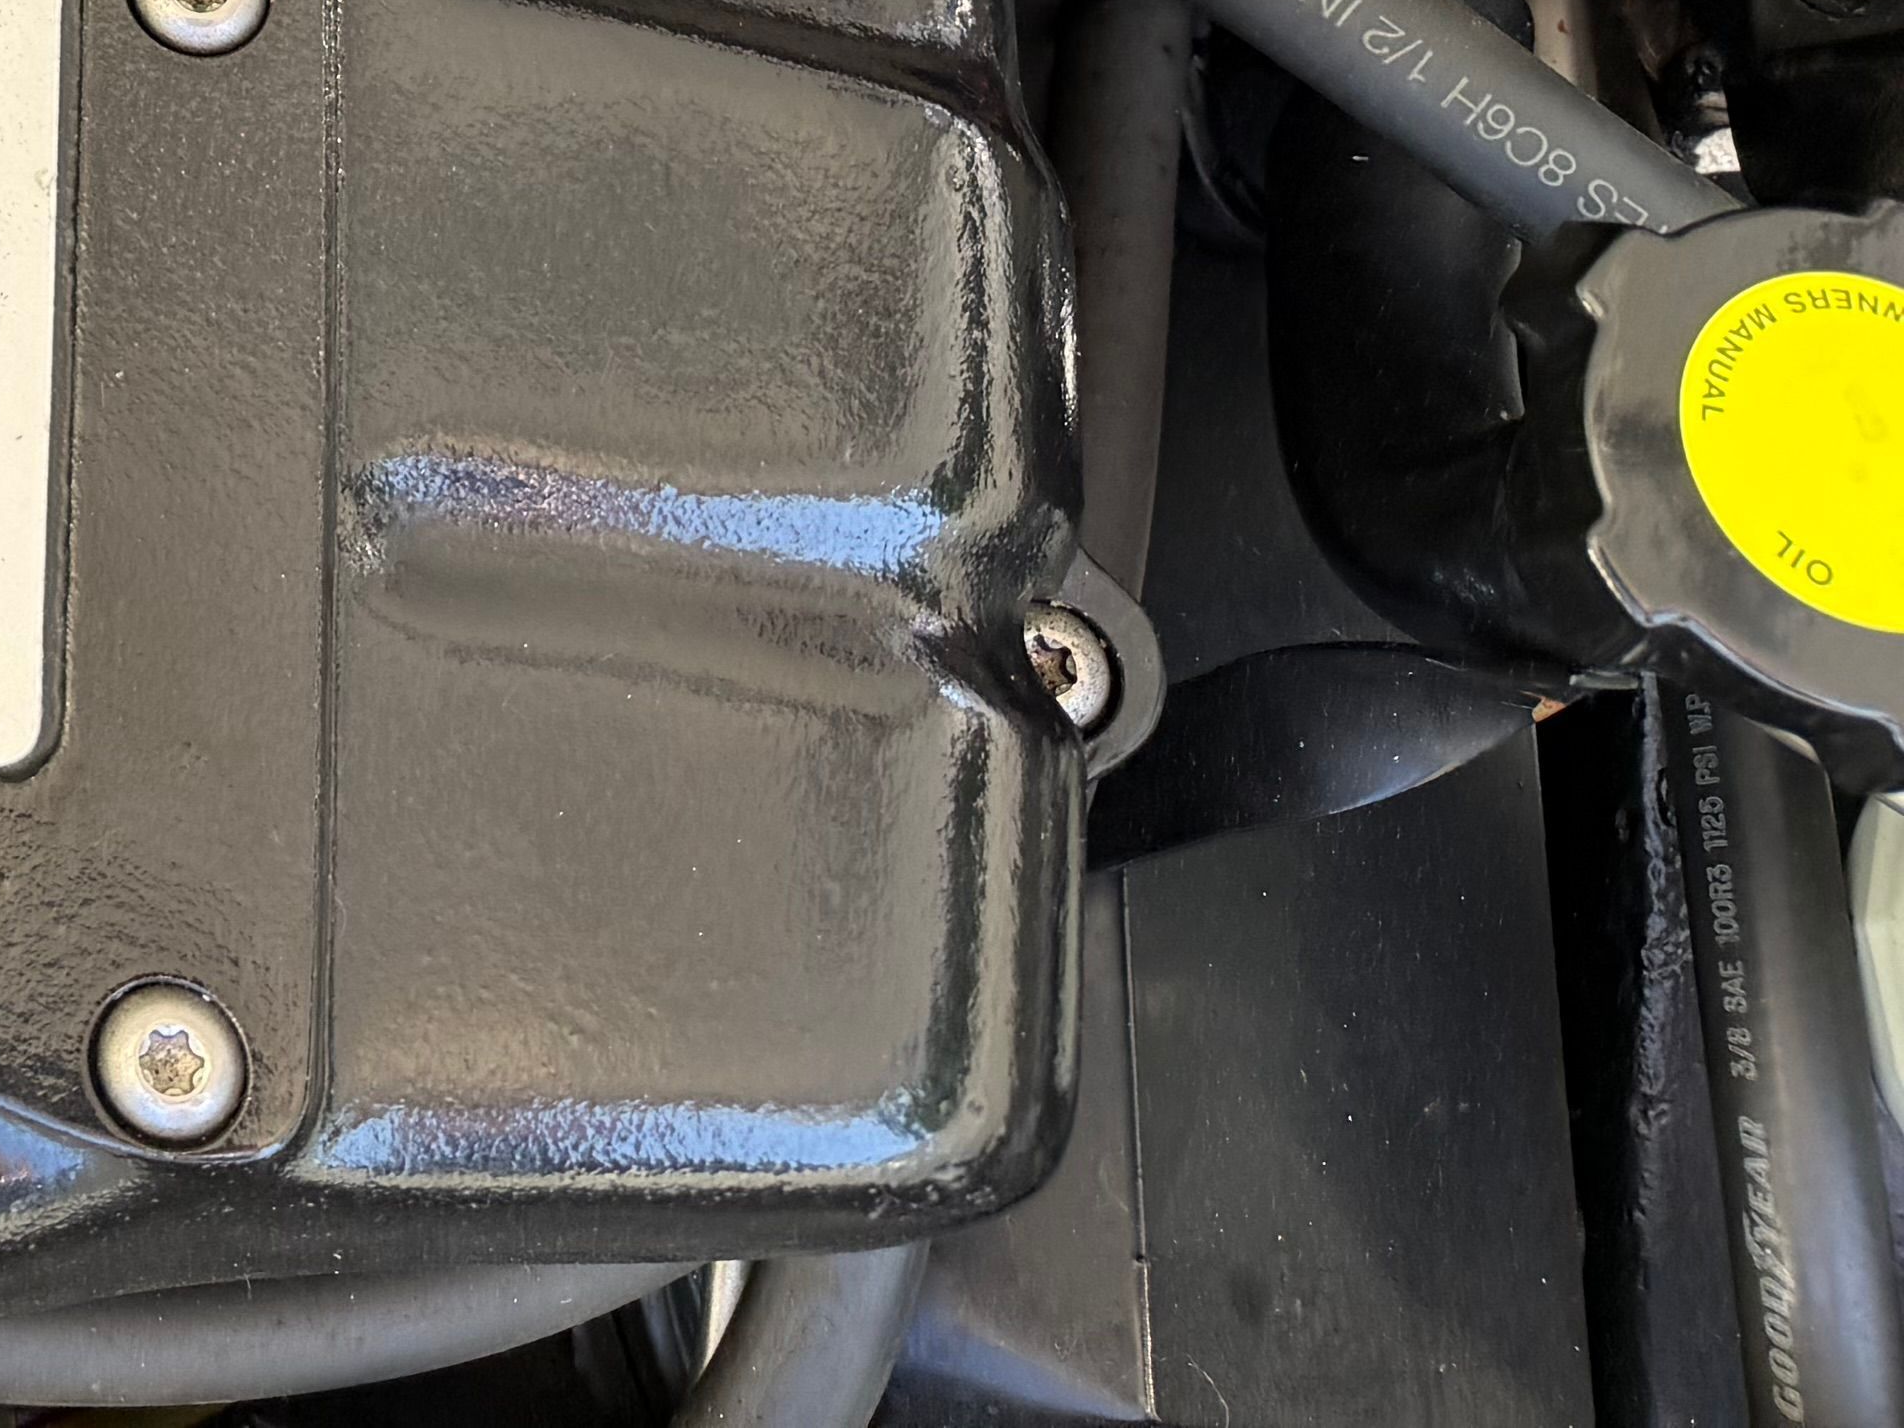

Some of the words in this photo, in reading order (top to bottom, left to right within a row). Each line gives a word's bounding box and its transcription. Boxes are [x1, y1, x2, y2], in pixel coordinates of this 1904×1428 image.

[1362, 15, 1436, 85] 1/2
[1440, 74, 1578, 188] 8C6H
[1701, 302, 1777, 422] MANUAL
[1777, 529, 1834, 586] OIL
[1692, 745, 1720, 785] PSI
[1698, 795, 1728, 853] 1125
[1706, 863, 1741, 948] 100R3
[1725, 1026, 1759, 1082] 3/8
[1737, 1114, 1805, 1424] GOODYEAR
